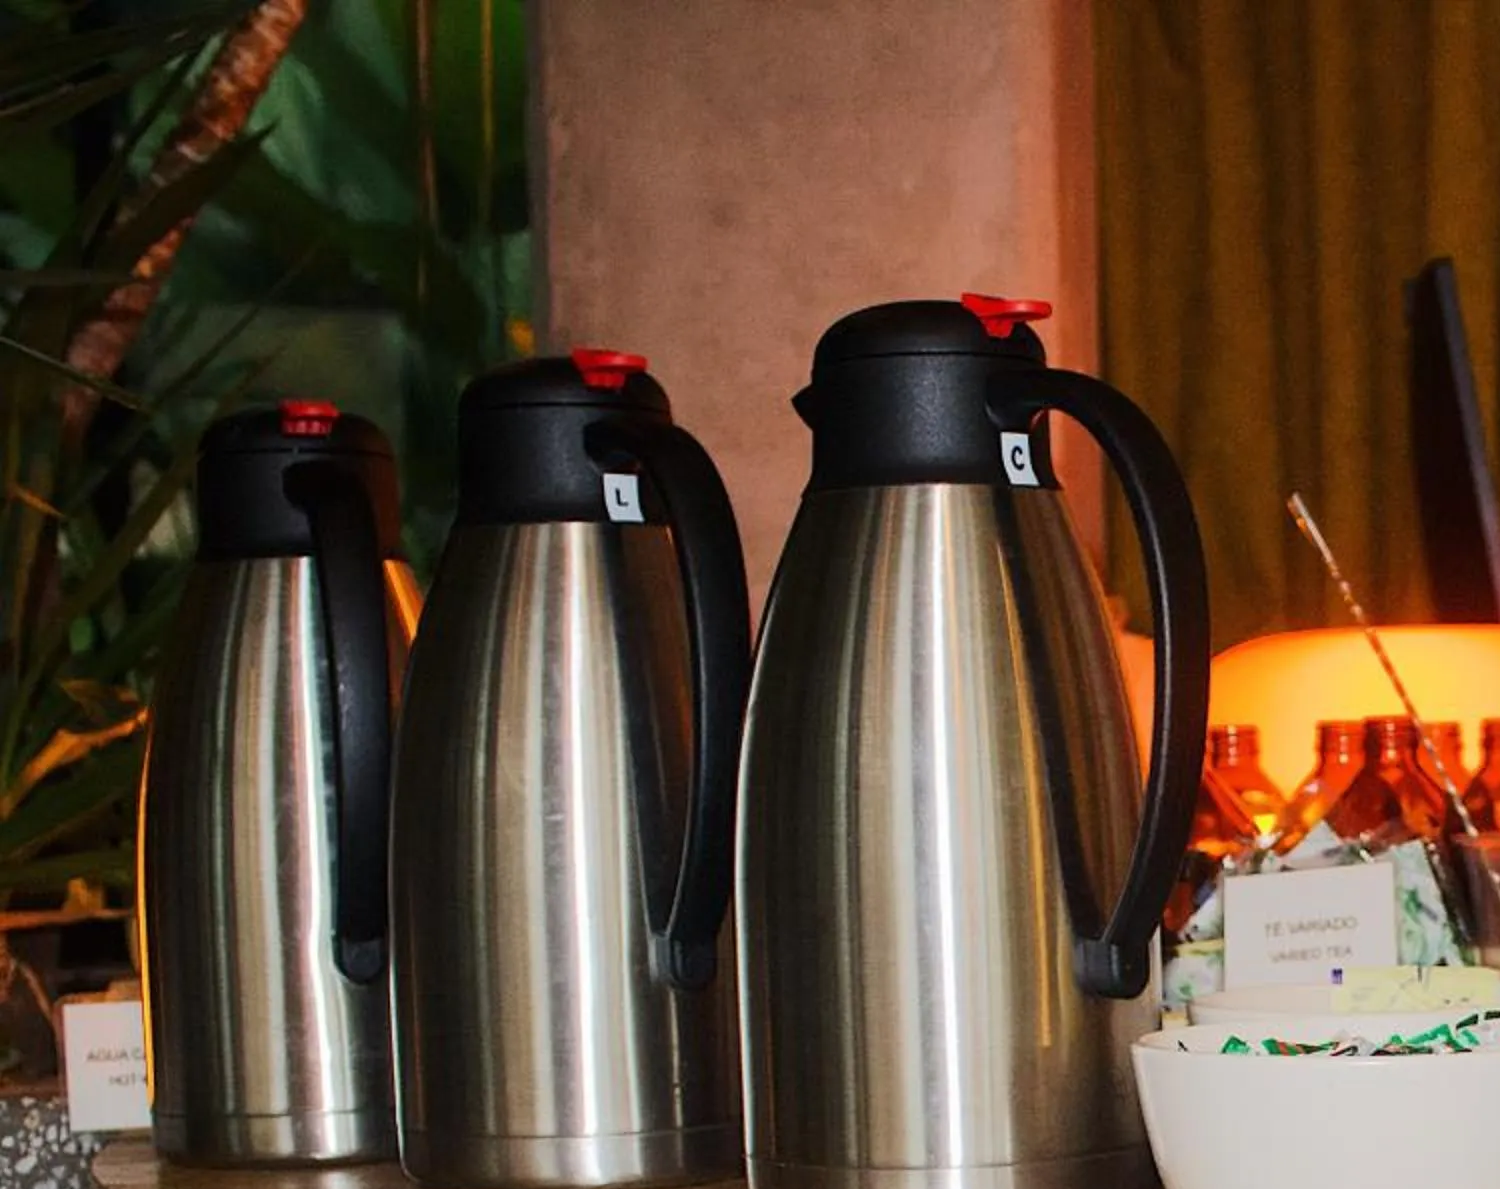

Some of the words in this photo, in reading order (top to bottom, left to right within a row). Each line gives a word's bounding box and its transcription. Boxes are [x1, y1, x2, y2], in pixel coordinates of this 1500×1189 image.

[1011, 445, 1025, 471] C
[615, 487, 629, 507] L
[1286, 916, 1359, 934] VARIADO
[1327, 945, 1353, 960] TEA
[86, 1047, 130, 1063] AGUA
